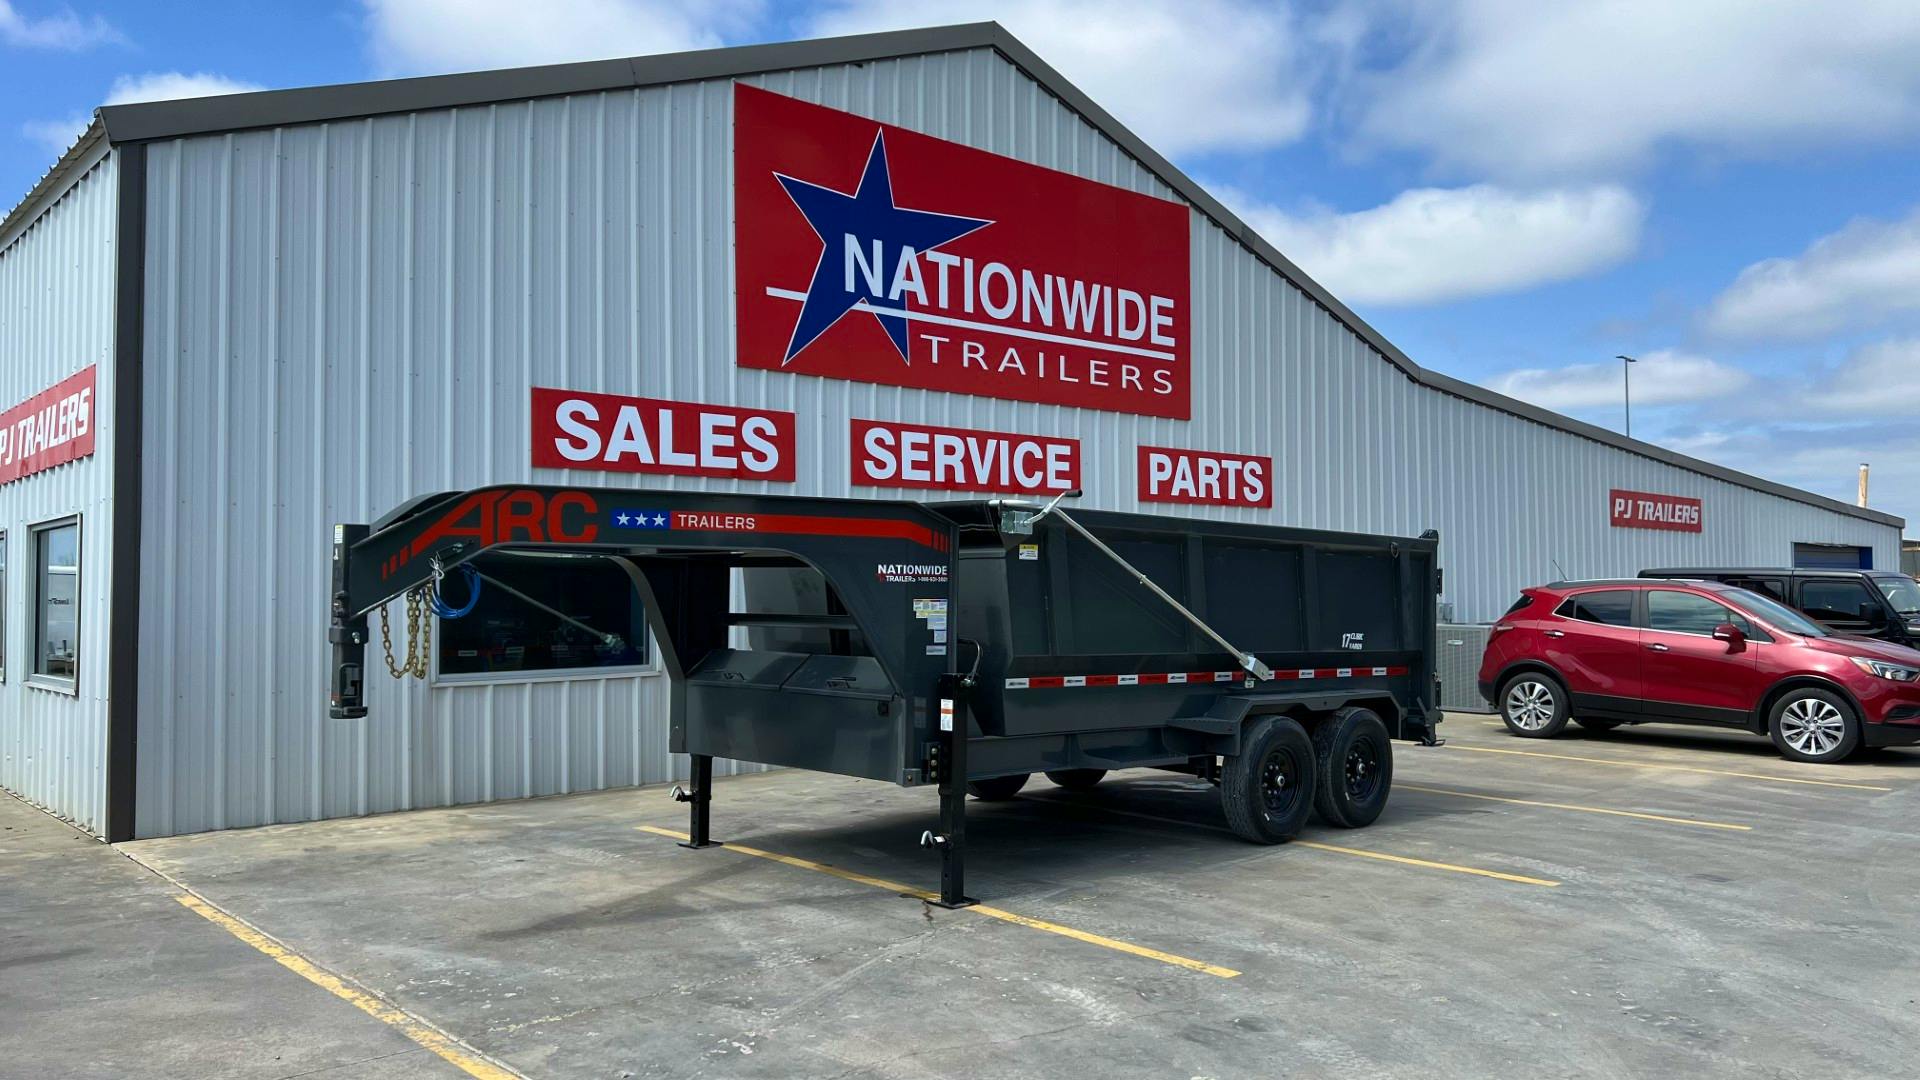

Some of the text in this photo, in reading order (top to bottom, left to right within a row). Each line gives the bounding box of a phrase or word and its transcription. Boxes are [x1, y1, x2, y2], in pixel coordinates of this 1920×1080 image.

[844, 232, 1176, 348] NATIONWIDE
[920, 333, 1173, 395] TRAILERS
[0, 387, 91, 465] PJ TRAILERS
[554, 399, 779, 473] SALES
[863, 427, 1073, 490] SERVICE
[1149, 453, 1265, 502] PARTS
[411, 489, 756, 556] ARC TRAILERS
[1614, 498, 1699, 524] PJ TRAILERS
[877, 564, 948, 575] NATIONWIDE
[1342, 633, 1351, 648] 17
